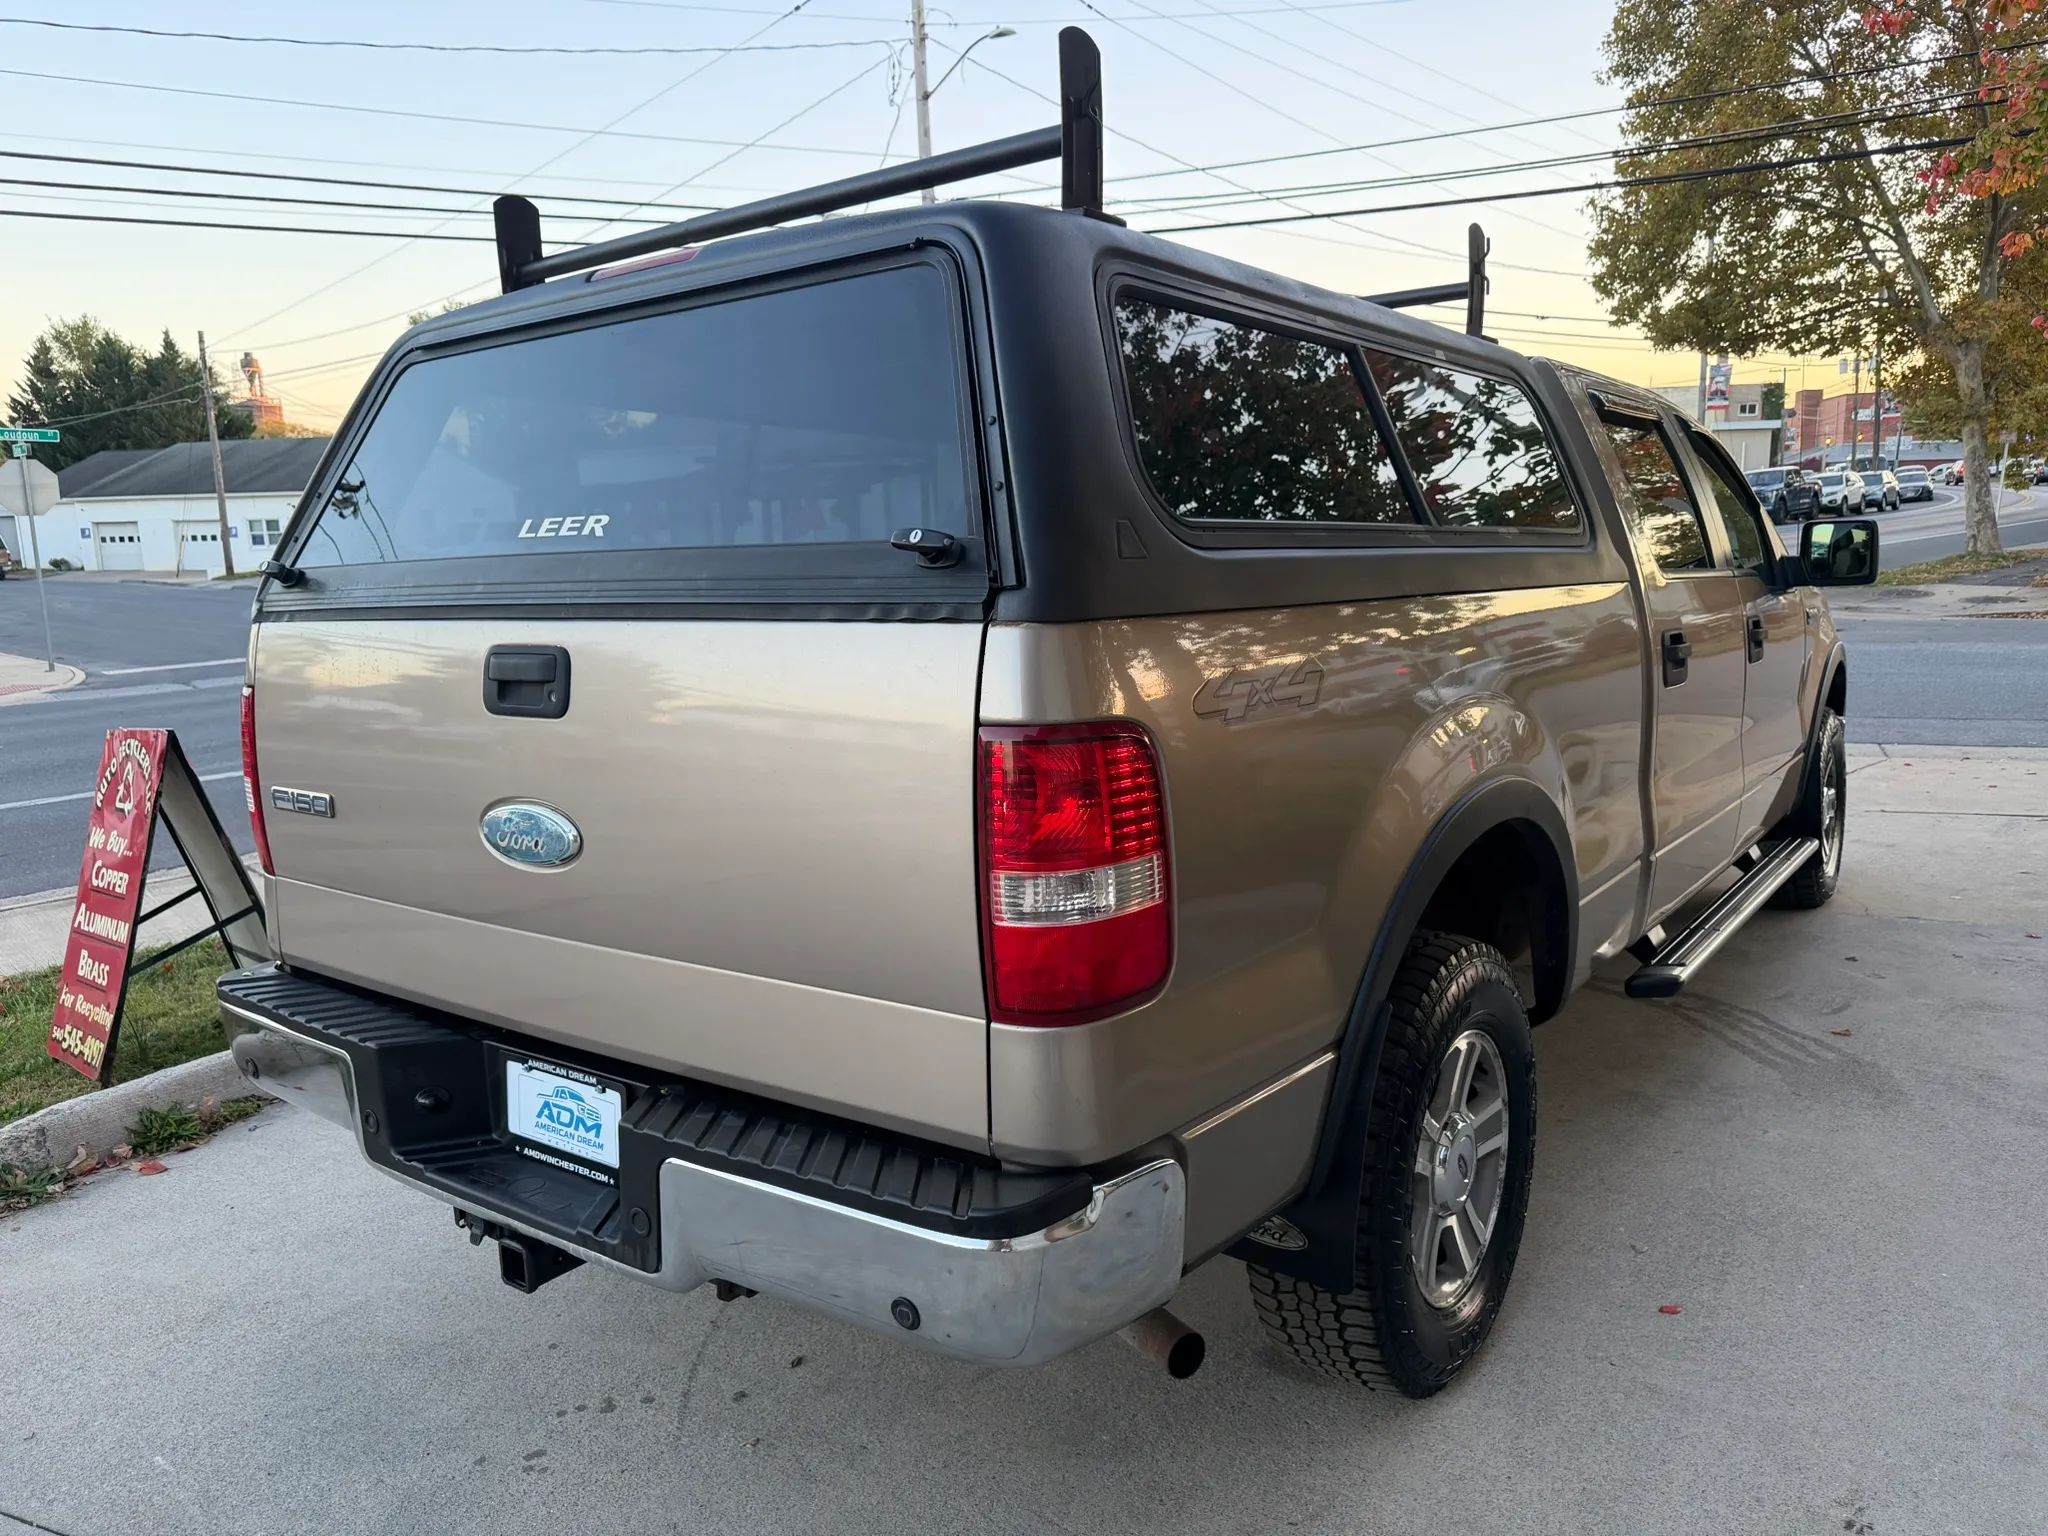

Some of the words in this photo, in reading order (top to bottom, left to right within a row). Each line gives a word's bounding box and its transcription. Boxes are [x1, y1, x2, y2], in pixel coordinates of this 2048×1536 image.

[517, 514, 611, 538] LEER
[96, 757, 118, 809] AUTO
[89, 826, 106, 850] We
[496, 816, 548, 853] Ford
[59, 983, 75, 1009] For
[75, 994, 115, 1033] Recycling
[52, 1025, 64, 1041] 540
[62, 1024, 105, 1068] 545-4197
[527, 1058, 567, 1078] AMERICAN
[568, 1069, 598, 1086] DREAM
[534, 1120, 576, 1141] AMERICAN
[576, 1135, 604, 1152] DREAM
[535, 1099, 603, 1139] ADM
[523, 1146, 609, 1184] AMDWINCHESTER.COM
